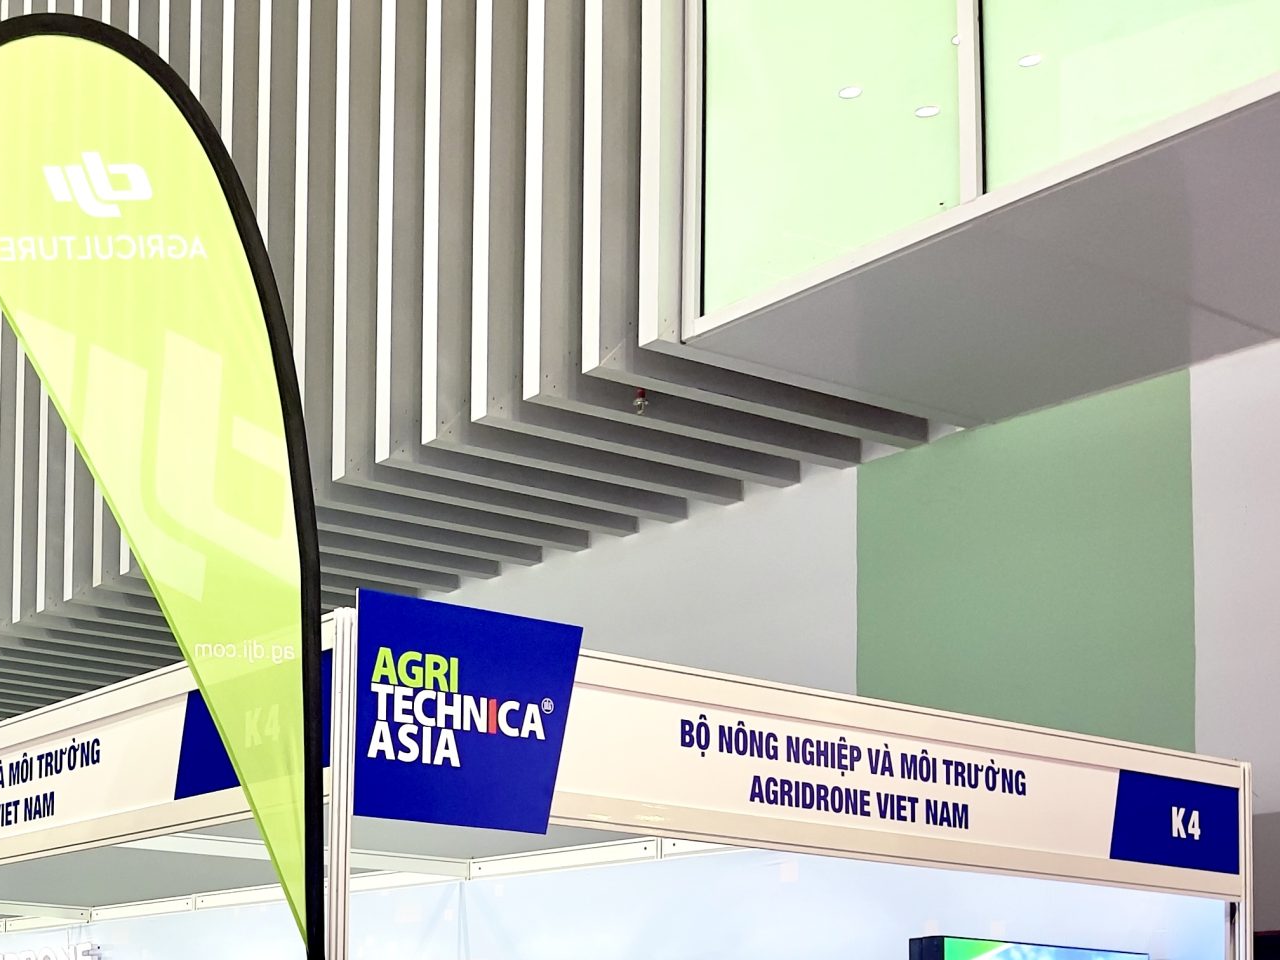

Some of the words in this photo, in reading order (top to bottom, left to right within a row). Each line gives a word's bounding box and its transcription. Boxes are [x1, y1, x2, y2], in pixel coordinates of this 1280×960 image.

[371, 646, 459, 693] AGRI
[8, 751, 34, 787] MÔI
[36, 738, 101, 779] TRƯỜNG
[367, 720, 461, 768] ASIA
[680, 714, 711, 758] BỘ
[718, 718, 779, 761] NÔNG
[786, 736, 862, 777] NGHIỆP
[867, 743, 894, 778] VÀ
[900, 749, 937, 783] MÔI
[942, 758, 1027, 796] TRƯỜNG
[23, 790, 55, 822] NAM
[749, 775, 871, 818] AGRIDRONE
[876, 791, 919, 823] VIET
[925, 798, 970, 830] NAM
[1170, 806, 1202, 842] K4
